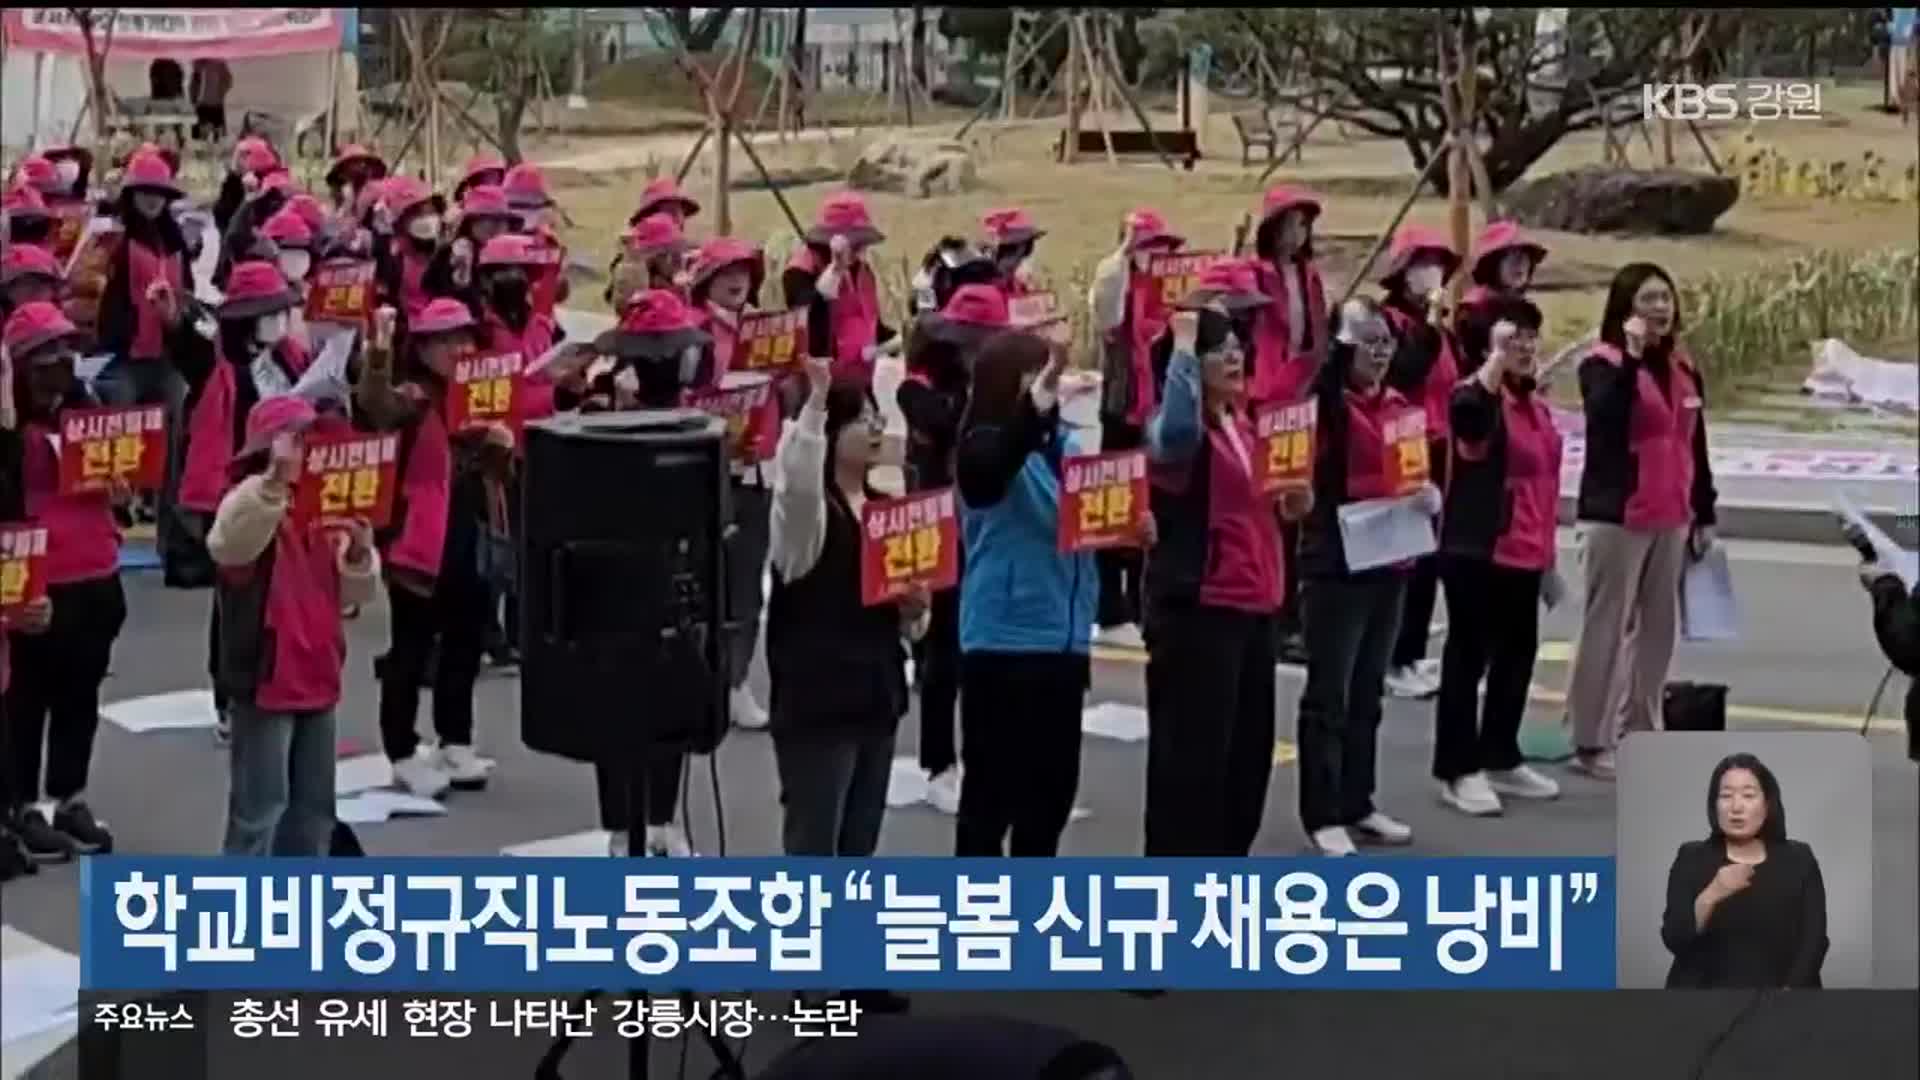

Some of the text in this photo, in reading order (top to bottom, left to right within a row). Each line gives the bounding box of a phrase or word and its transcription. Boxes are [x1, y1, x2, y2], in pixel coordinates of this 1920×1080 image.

[467, 376, 513, 417] 전환
[81, 435, 146, 477] 전환
[1268, 430, 1311, 473] 전환
[319, 469, 379, 513] 전환
[1079, 486, 1134, 531] 전환
[883, 526, 941, 579] 전환
